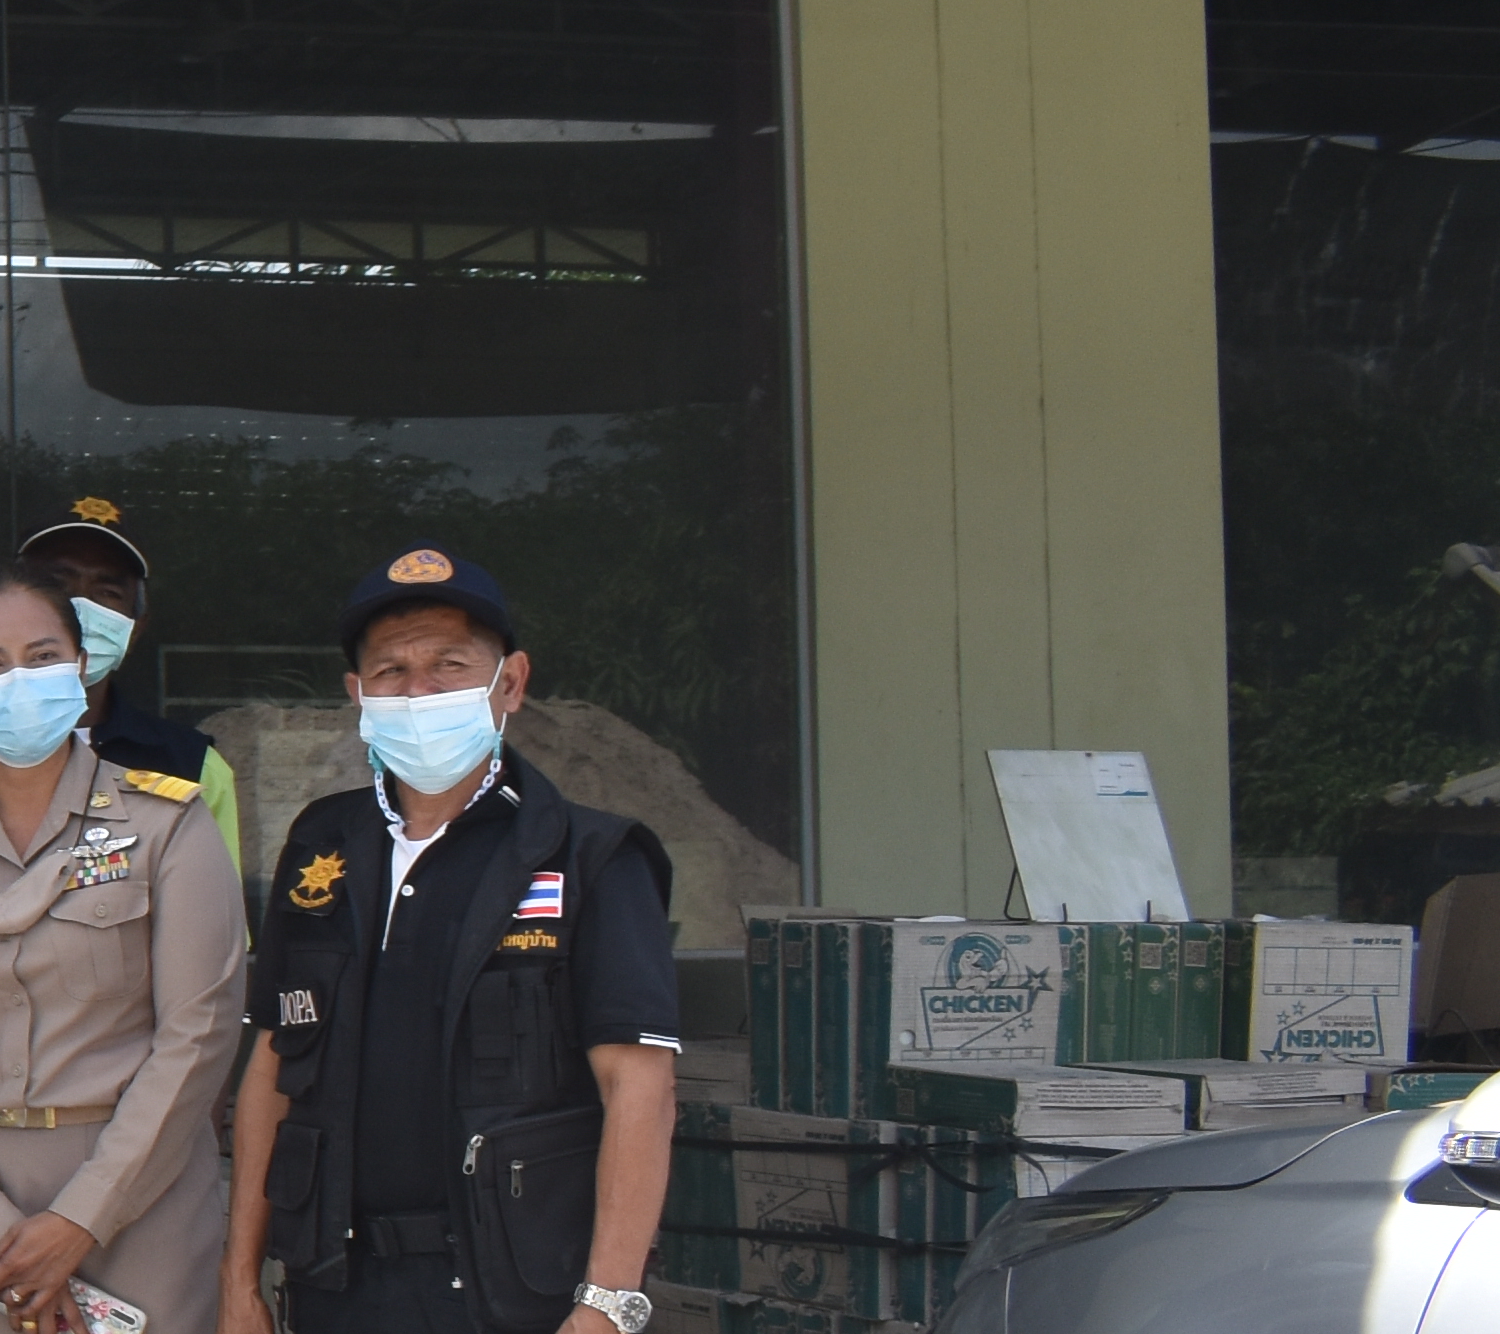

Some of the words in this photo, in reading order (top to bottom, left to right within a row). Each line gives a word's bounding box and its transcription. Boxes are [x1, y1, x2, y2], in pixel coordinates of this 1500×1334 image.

[278, 989, 318, 1026] DOPA
[927, 994, 1024, 1014] CHICKEN
[1286, 1029, 1377, 1049] CHICKEN
